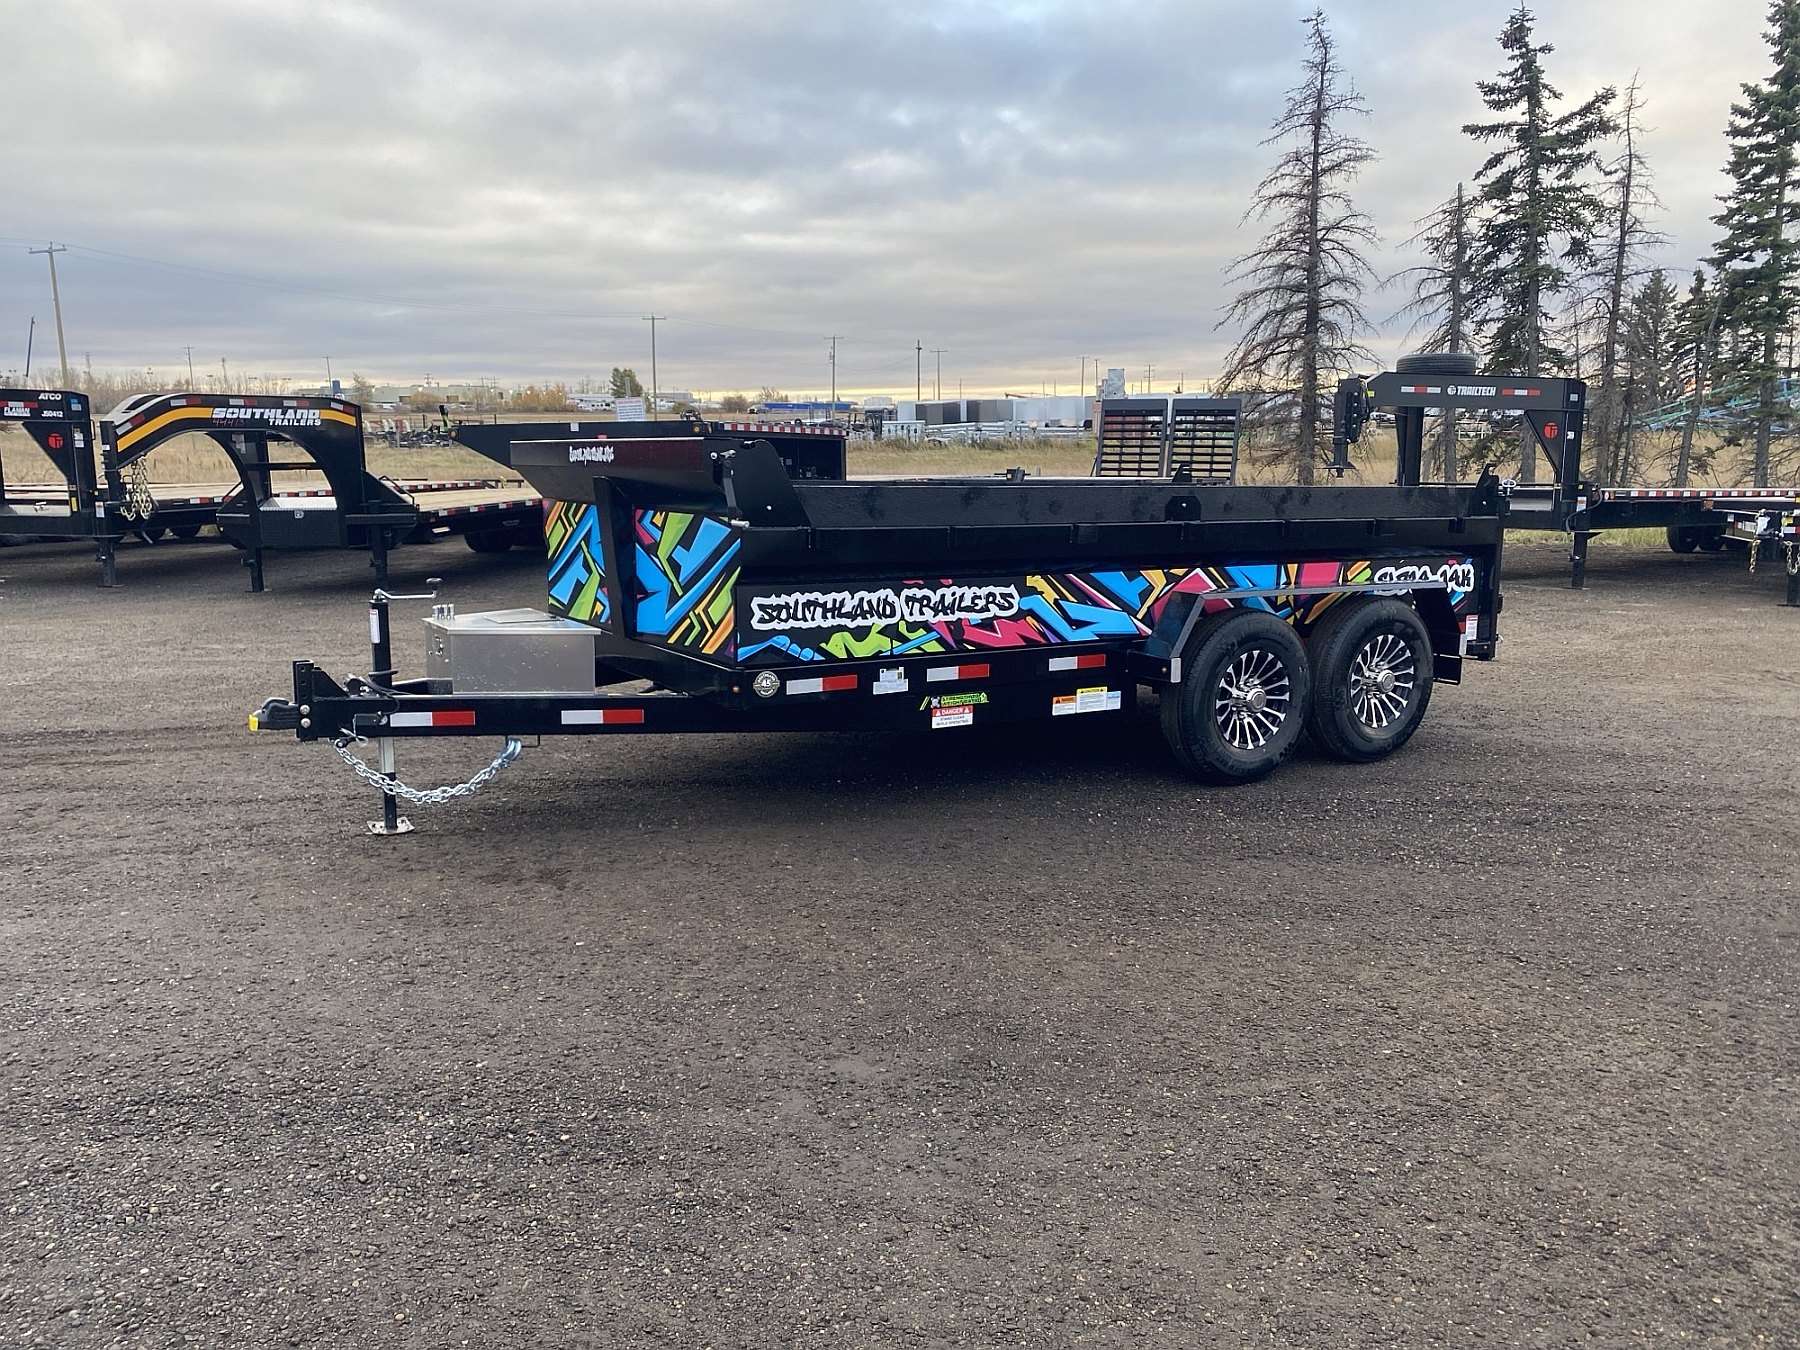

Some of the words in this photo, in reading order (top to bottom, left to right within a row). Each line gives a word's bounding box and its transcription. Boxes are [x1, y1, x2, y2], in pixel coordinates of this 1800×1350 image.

[1457, 386, 1497, 396] TRAILTECH
[38, 392, 62, 400] ATCO
[212, 407, 320, 419] SOUTHLAND
[268, 418, 321, 426] TRAILERS
[756, 592, 898, 625] SOUTHLAND
[941, 707, 963, 715] DANGER
